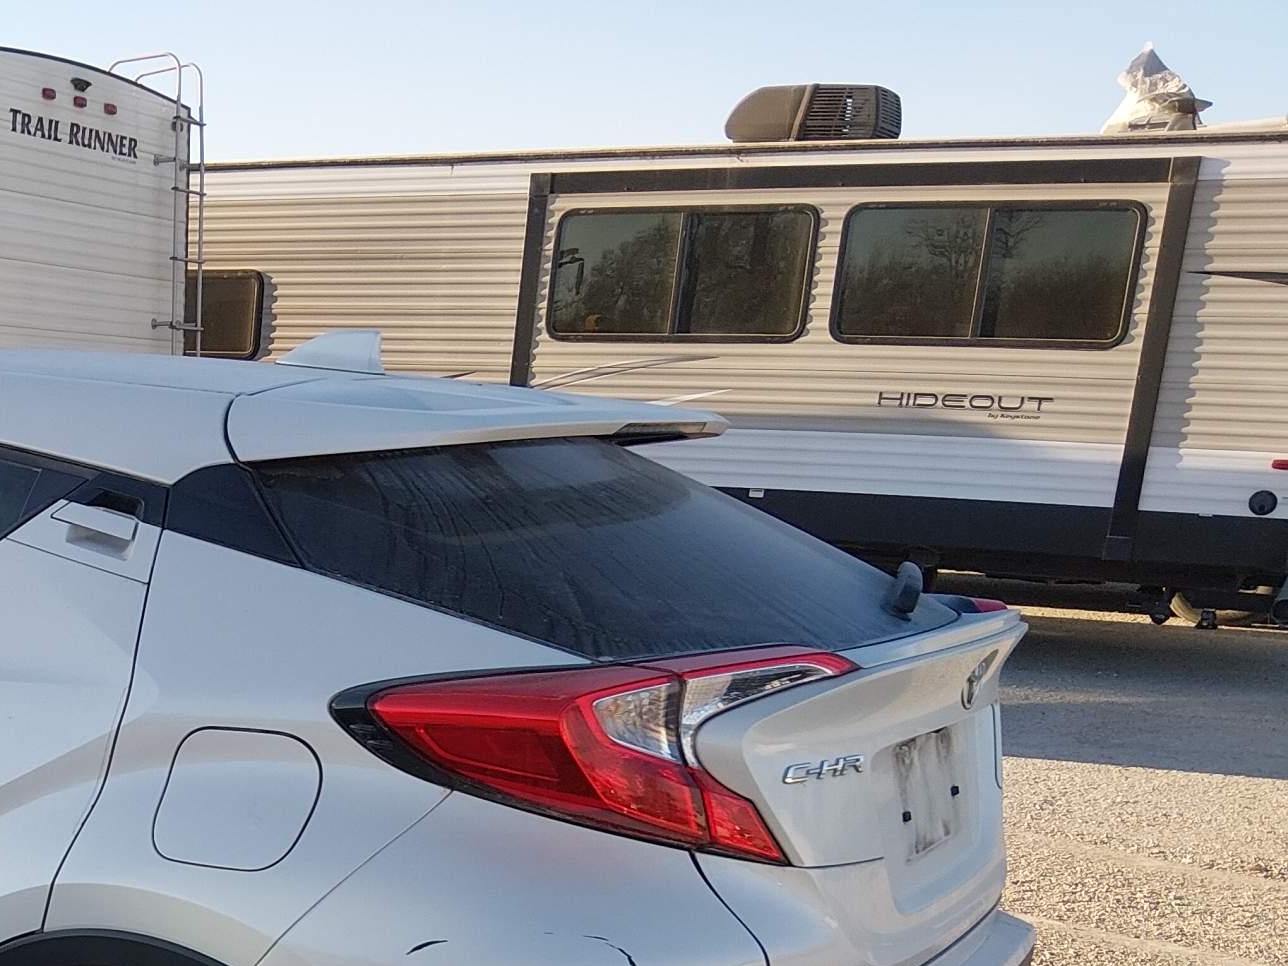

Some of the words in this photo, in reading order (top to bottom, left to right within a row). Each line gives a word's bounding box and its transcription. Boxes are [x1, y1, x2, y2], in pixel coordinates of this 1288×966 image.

[9, 108, 62, 142] TRAIL
[68, 122, 138, 159] RUNNER
[877, 391, 1054, 411] HIDEOUT
[782, 754, 864, 784] C-HR
